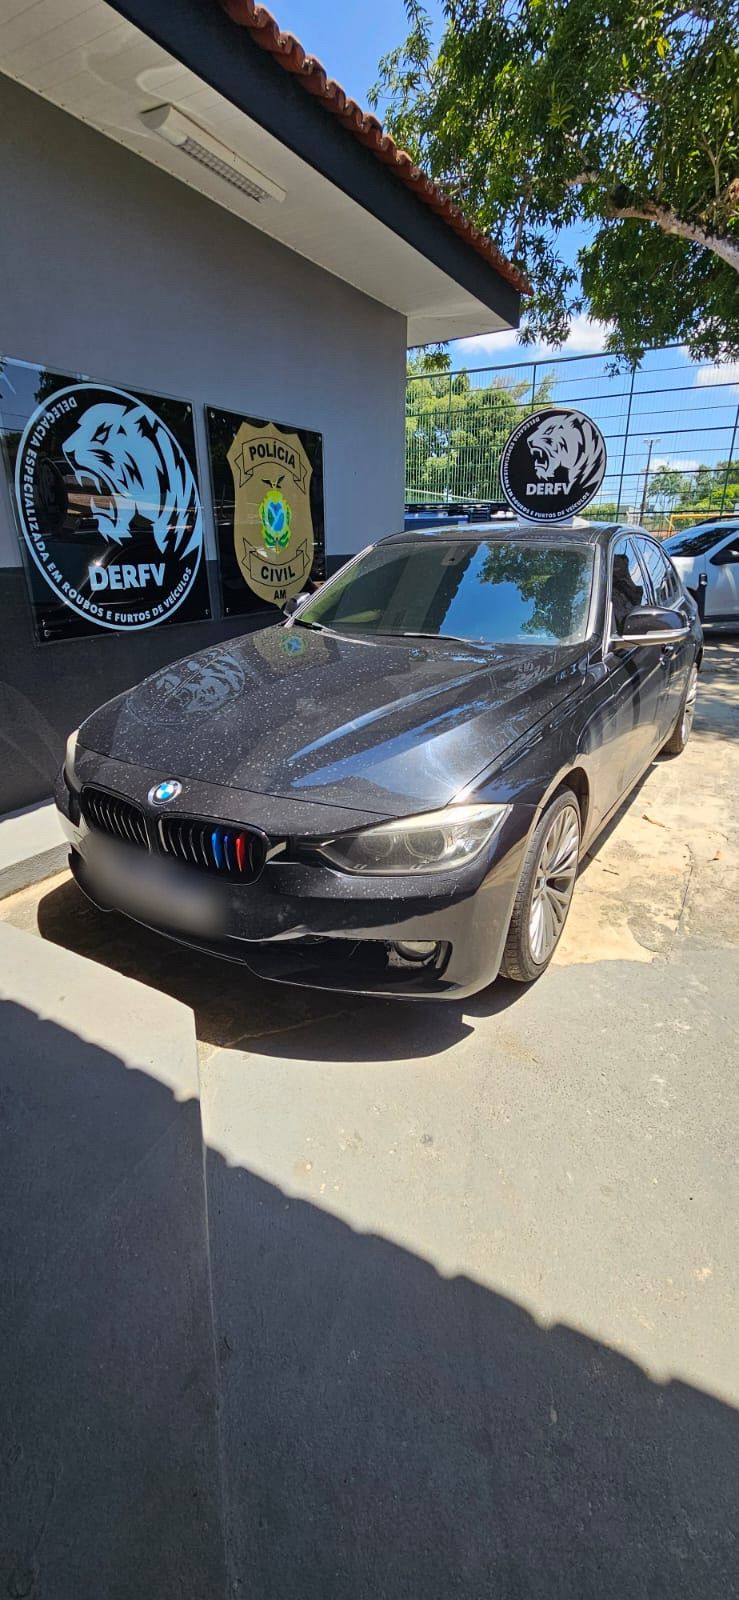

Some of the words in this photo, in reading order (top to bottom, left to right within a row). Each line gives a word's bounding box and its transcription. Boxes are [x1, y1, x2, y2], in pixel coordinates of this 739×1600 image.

[30, 396, 78, 447] DELEGACIA
[249, 440, 296, 469] POLÍCIA
[526, 482, 571, 496] DERFV
[23, 448, 50, 562] ESPECIALIZADA
[46, 562, 63, 583] EM
[88, 563, 166, 591] DERFV
[261, 565, 296, 582] CIVIL
[165, 567, 193, 609] VEÍCULOS
[273, 589, 287, 600] AM
[61, 582, 104, 617] ROUBOS
[106, 611, 113, 620] E
[114, 612, 151, 623] FURTOS
[152, 605, 164, 617] DE
